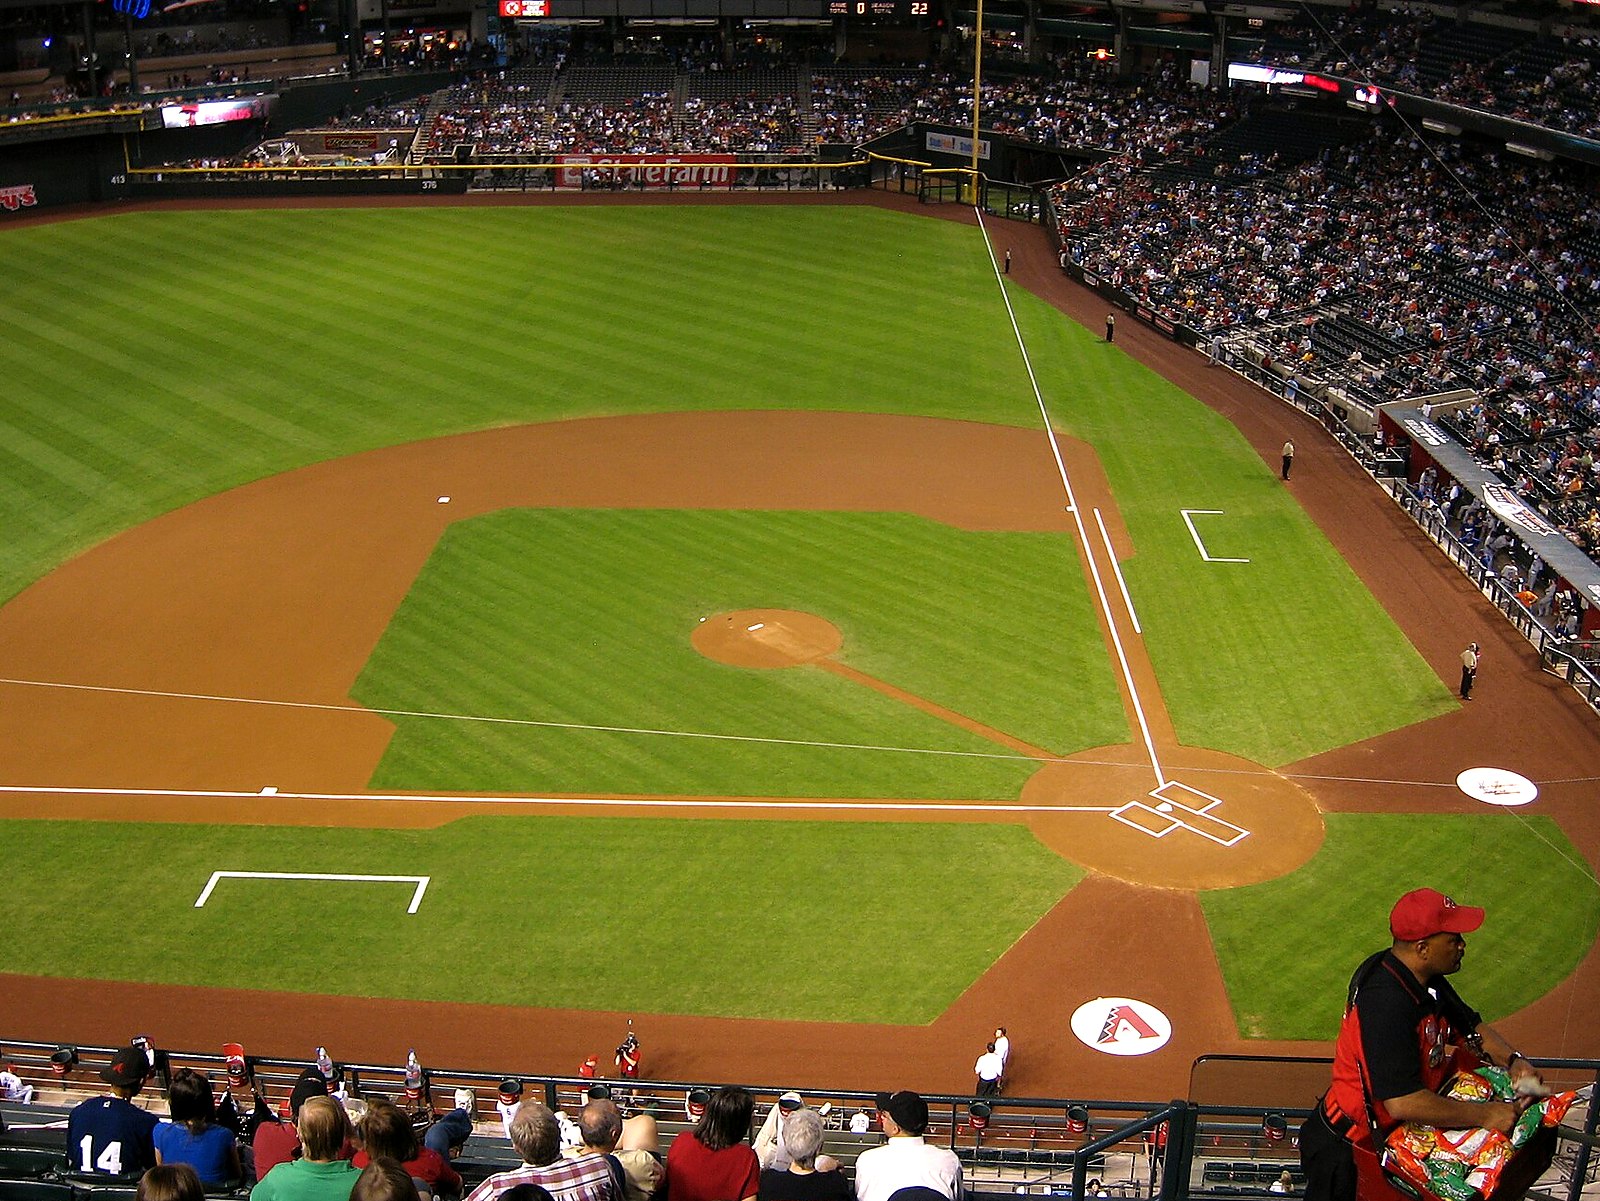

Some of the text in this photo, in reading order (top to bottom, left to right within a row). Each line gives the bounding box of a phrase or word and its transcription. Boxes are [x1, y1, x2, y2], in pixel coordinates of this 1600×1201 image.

[856, 2, 865, 14] 0
[911, 2, 928, 15] 22
[111, 175, 125, 184] 413
[80, 1134, 122, 1175] 14
